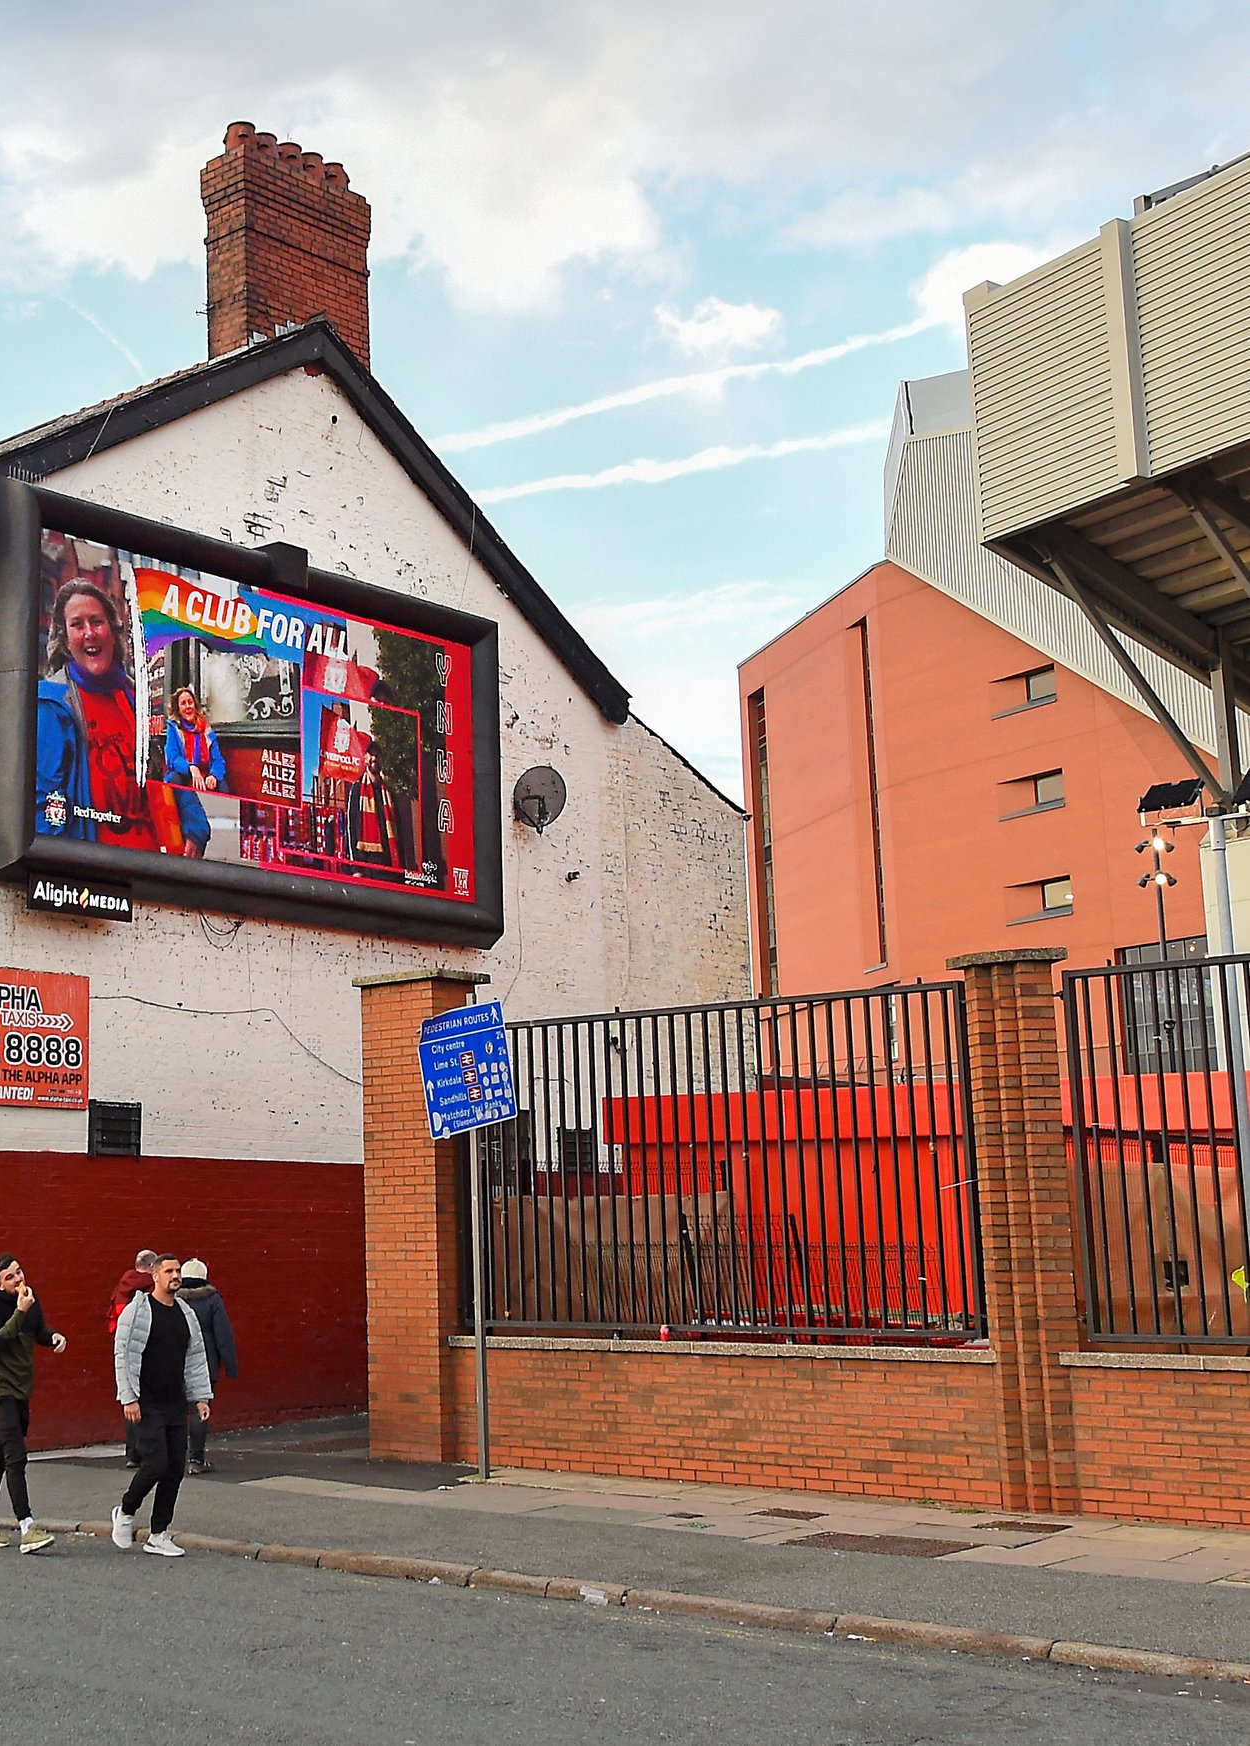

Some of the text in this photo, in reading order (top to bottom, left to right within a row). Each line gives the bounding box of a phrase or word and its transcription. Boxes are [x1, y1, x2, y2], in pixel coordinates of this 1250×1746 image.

[160, 584, 350, 662] A CLUB FOR ALL
[261, 748, 296, 769] ALLEZ
[261, 764, 296, 783] ALLEZ
[261, 780, 296, 799] ALLEZ
[33, 880, 130, 912] Alight MEDIA
[0, 1009, 37, 1026] TAXIS
[423, 1012, 490, 1035] PEDESTRIAN ROUTES
[4, 1033, 83, 1069] 8888
[431, 1044, 445, 1054] City
[445, 1041, 465, 1051] centre
[433, 1061, 449, 1071] Lime
[450, 1057, 459, 1067] St.
[2, 1069, 23, 1082] THE
[25, 1070, 60, 1084] ALPHA
[62, 1073, 83, 1086] APP
[436, 1075, 462, 1088] Kirkdale
[439, 1092, 467, 1107] Sandhills
[440, 1108, 470, 1122] Matchday
